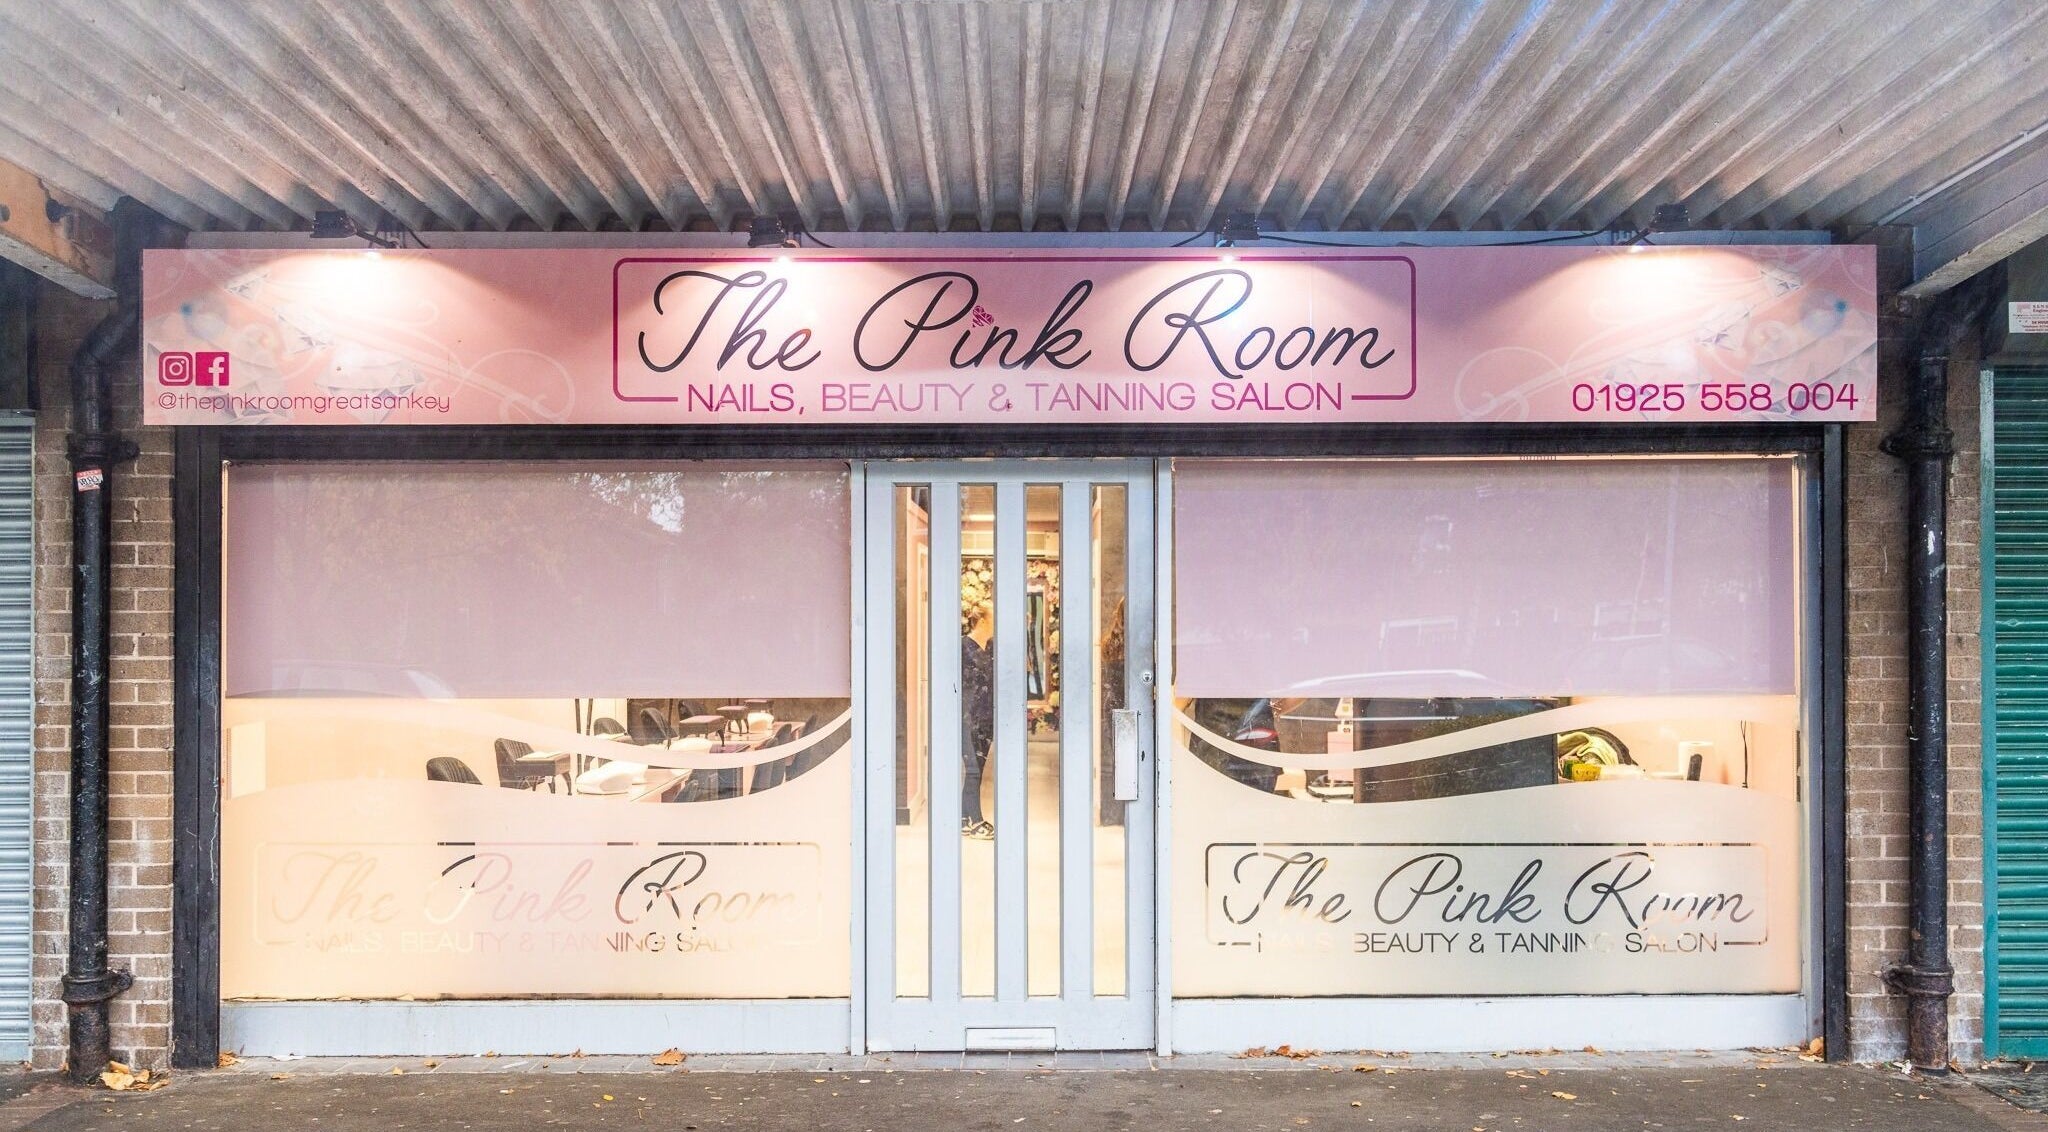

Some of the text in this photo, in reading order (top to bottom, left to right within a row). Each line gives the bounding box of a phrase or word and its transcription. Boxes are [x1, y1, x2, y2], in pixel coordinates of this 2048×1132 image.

[638, 269, 1395, 380] The Pink Room
[158, 391, 450, 413] @thepinkroomgreatsankey
[688, 383, 1342, 414] NAILS, BEAUTY & TANNING SALON
[1572, 383, 1858, 411] 01925 558 004
[272, 850, 806, 930] The Pink Room
[1223, 852, 1754, 930] The Pink Room
[401, 932, 509, 953] BEAUTY
[1354, 932, 1460, 953] BEAUTY
[1469, 932, 1484, 953] &
[1625, 932, 1717, 953] SALON
